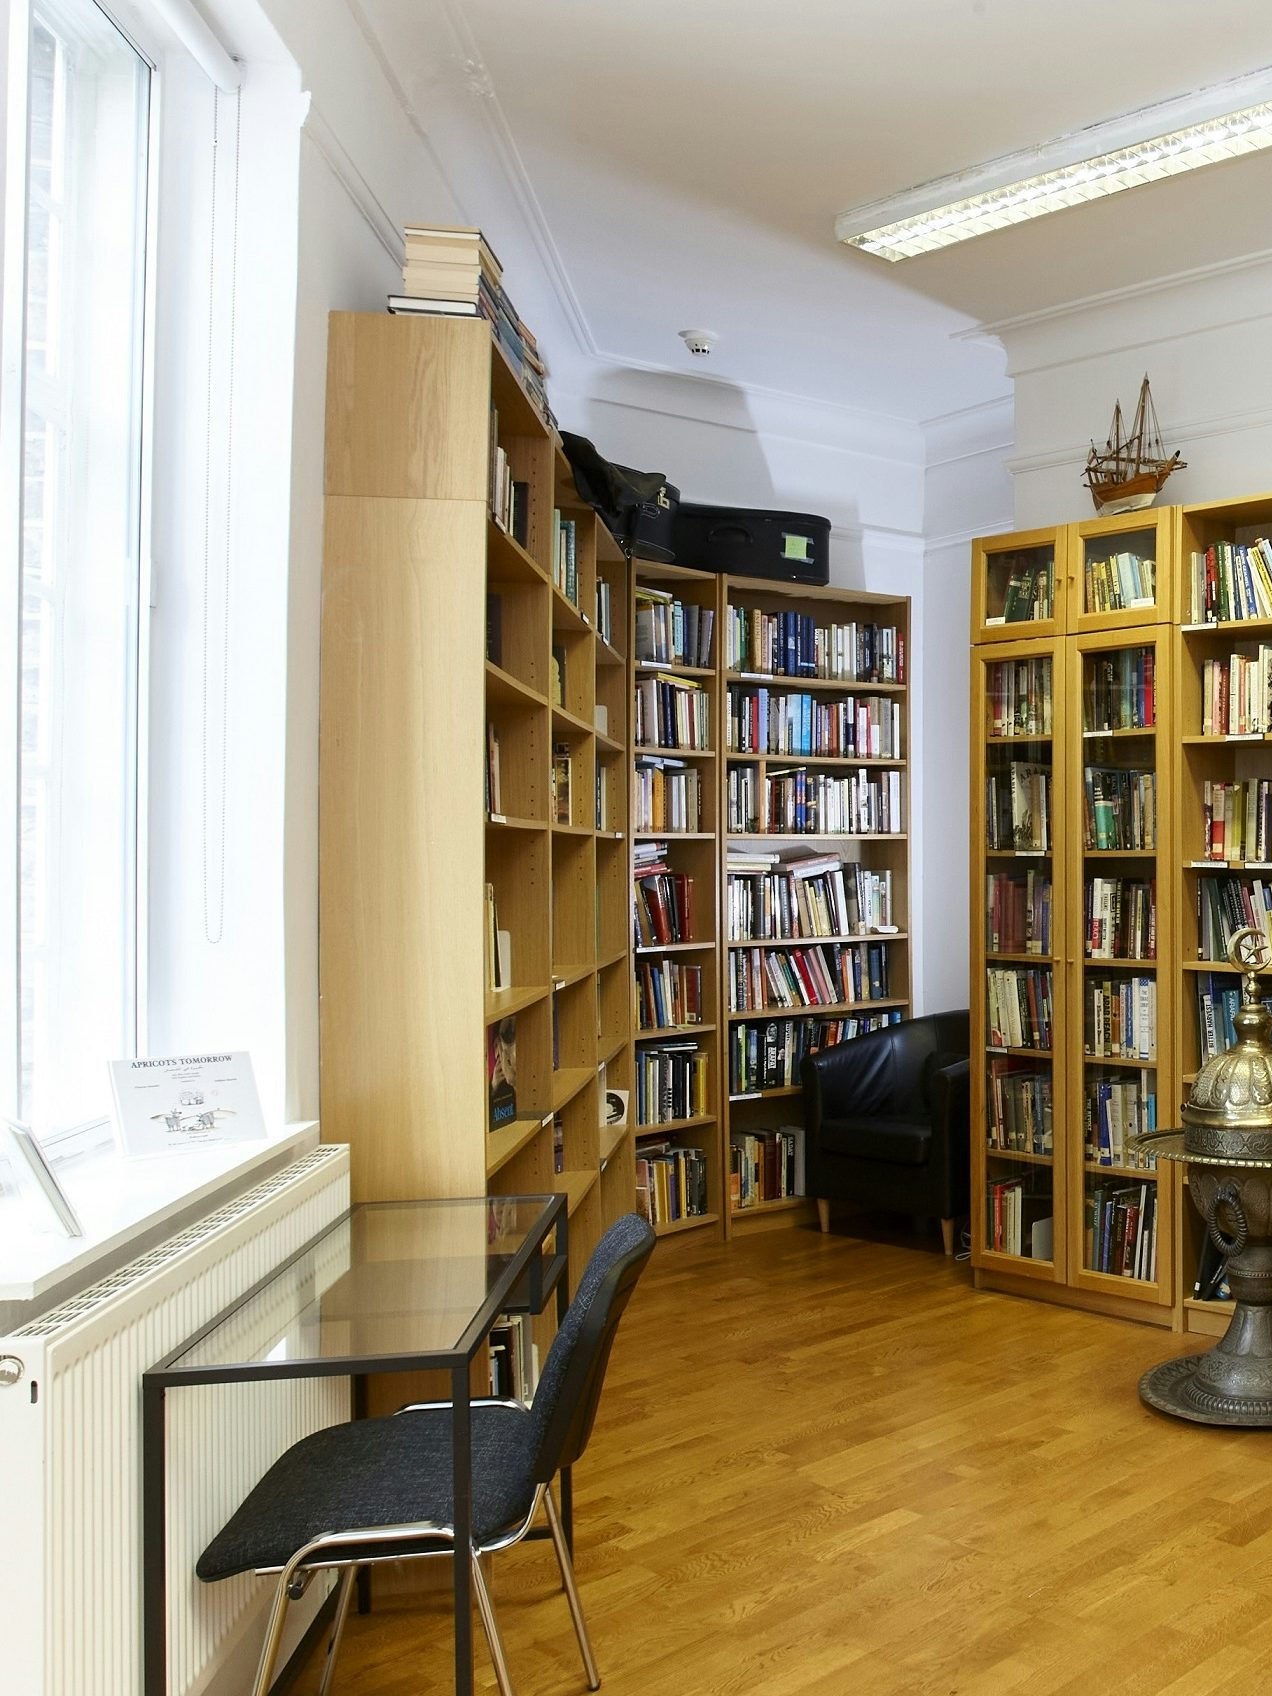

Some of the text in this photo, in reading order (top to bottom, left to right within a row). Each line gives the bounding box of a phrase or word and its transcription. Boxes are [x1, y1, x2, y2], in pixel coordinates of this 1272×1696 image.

[1092, 918, 1100, 940] IRAQ
[131, 1055, 233, 1069] APRICOTS TOMORROW
[494, 1103, 514, 1121] Absent
